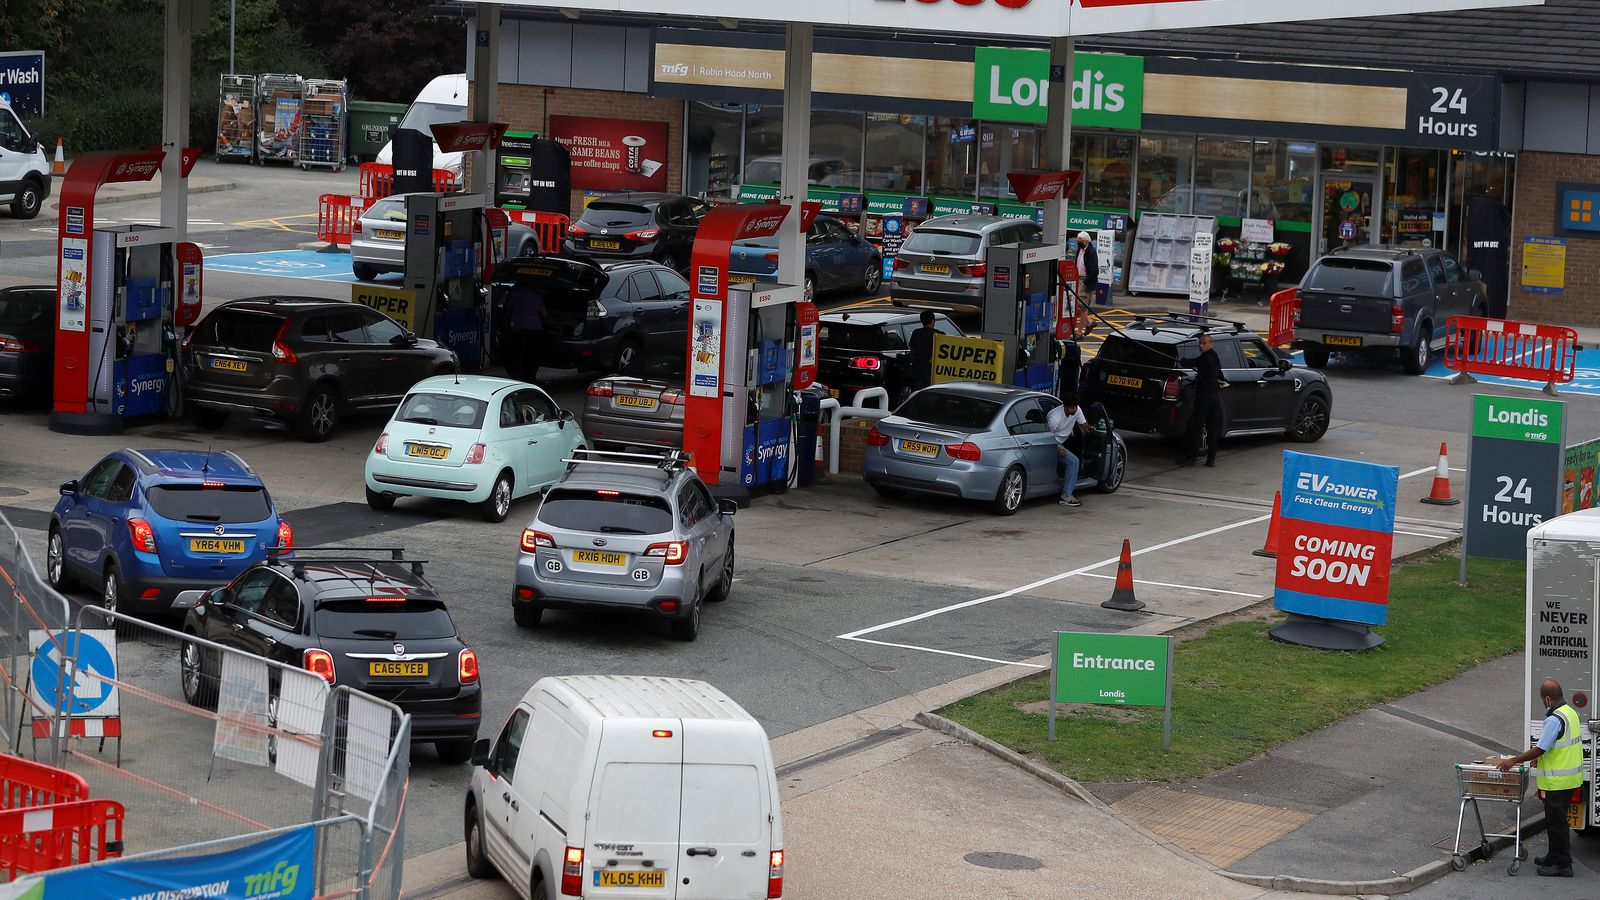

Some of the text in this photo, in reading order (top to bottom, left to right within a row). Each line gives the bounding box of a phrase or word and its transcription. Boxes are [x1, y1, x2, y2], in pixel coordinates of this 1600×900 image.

[7, 67, 39, 84] Wash
[661, 63, 689, 76] mfg
[700, 66, 772, 80] Robin Hood North
[1430, 86, 1468, 115] 24
[1418, 116, 1478, 137] Hours
[573, 136, 598, 147] FRESH
[572, 147, 620, 160] SAME BEANS
[183, 156, 189, 165] 9
[583, 159, 601, 168] coffee
[601, 161, 620, 171] shops
[126, 164, 155, 176] Synergy
[802, 210, 809, 220] 7
[1082, 218, 1099, 226] CARE
[358, 294, 409, 314] SUPER
[448, 330, 478, 344] Synergy
[937, 343, 997, 365] SUPER
[214, 359, 246, 370] EN64 XEV
[935, 365, 997, 382] UNLEADED
[620, 395, 638, 404] BT07
[1488, 405, 1548, 427] Londis
[430, 448, 446, 457] OCJ
[902, 440, 937, 454] LR59 WOH
[1494, 475, 1532, 504] 24
[1294, 495, 1374, 515] Fast Clean Energy
[1482, 504, 1542, 527] Hours
[195, 540, 241, 551] YR64 VHM
[1294, 534, 1376, 561] COMING
[578, 551, 620, 564] RX16 HDH
[547, 561, 561, 571] GB
[1290, 555, 1371, 587] SOON
[633, 570, 648, 580] GB
[1546, 601, 1560, 609] WE
[1540, 610, 1588, 625] NEVER
[1550, 625, 1570, 633] ADD
[1539, 635, 1588, 648] ARTIFICIAL
[1539, 647, 1588, 659] INGREDIENTS
[1072, 652, 1155, 671] Entrance
[374, 663, 424, 674] CA65 YEB
[1099, 689, 1125, 698] Londis
[244, 860, 300, 897] mfg
[602, 872, 663, 886] YL05 KHH
[156, 880, 230, 900] DISRUPTION
